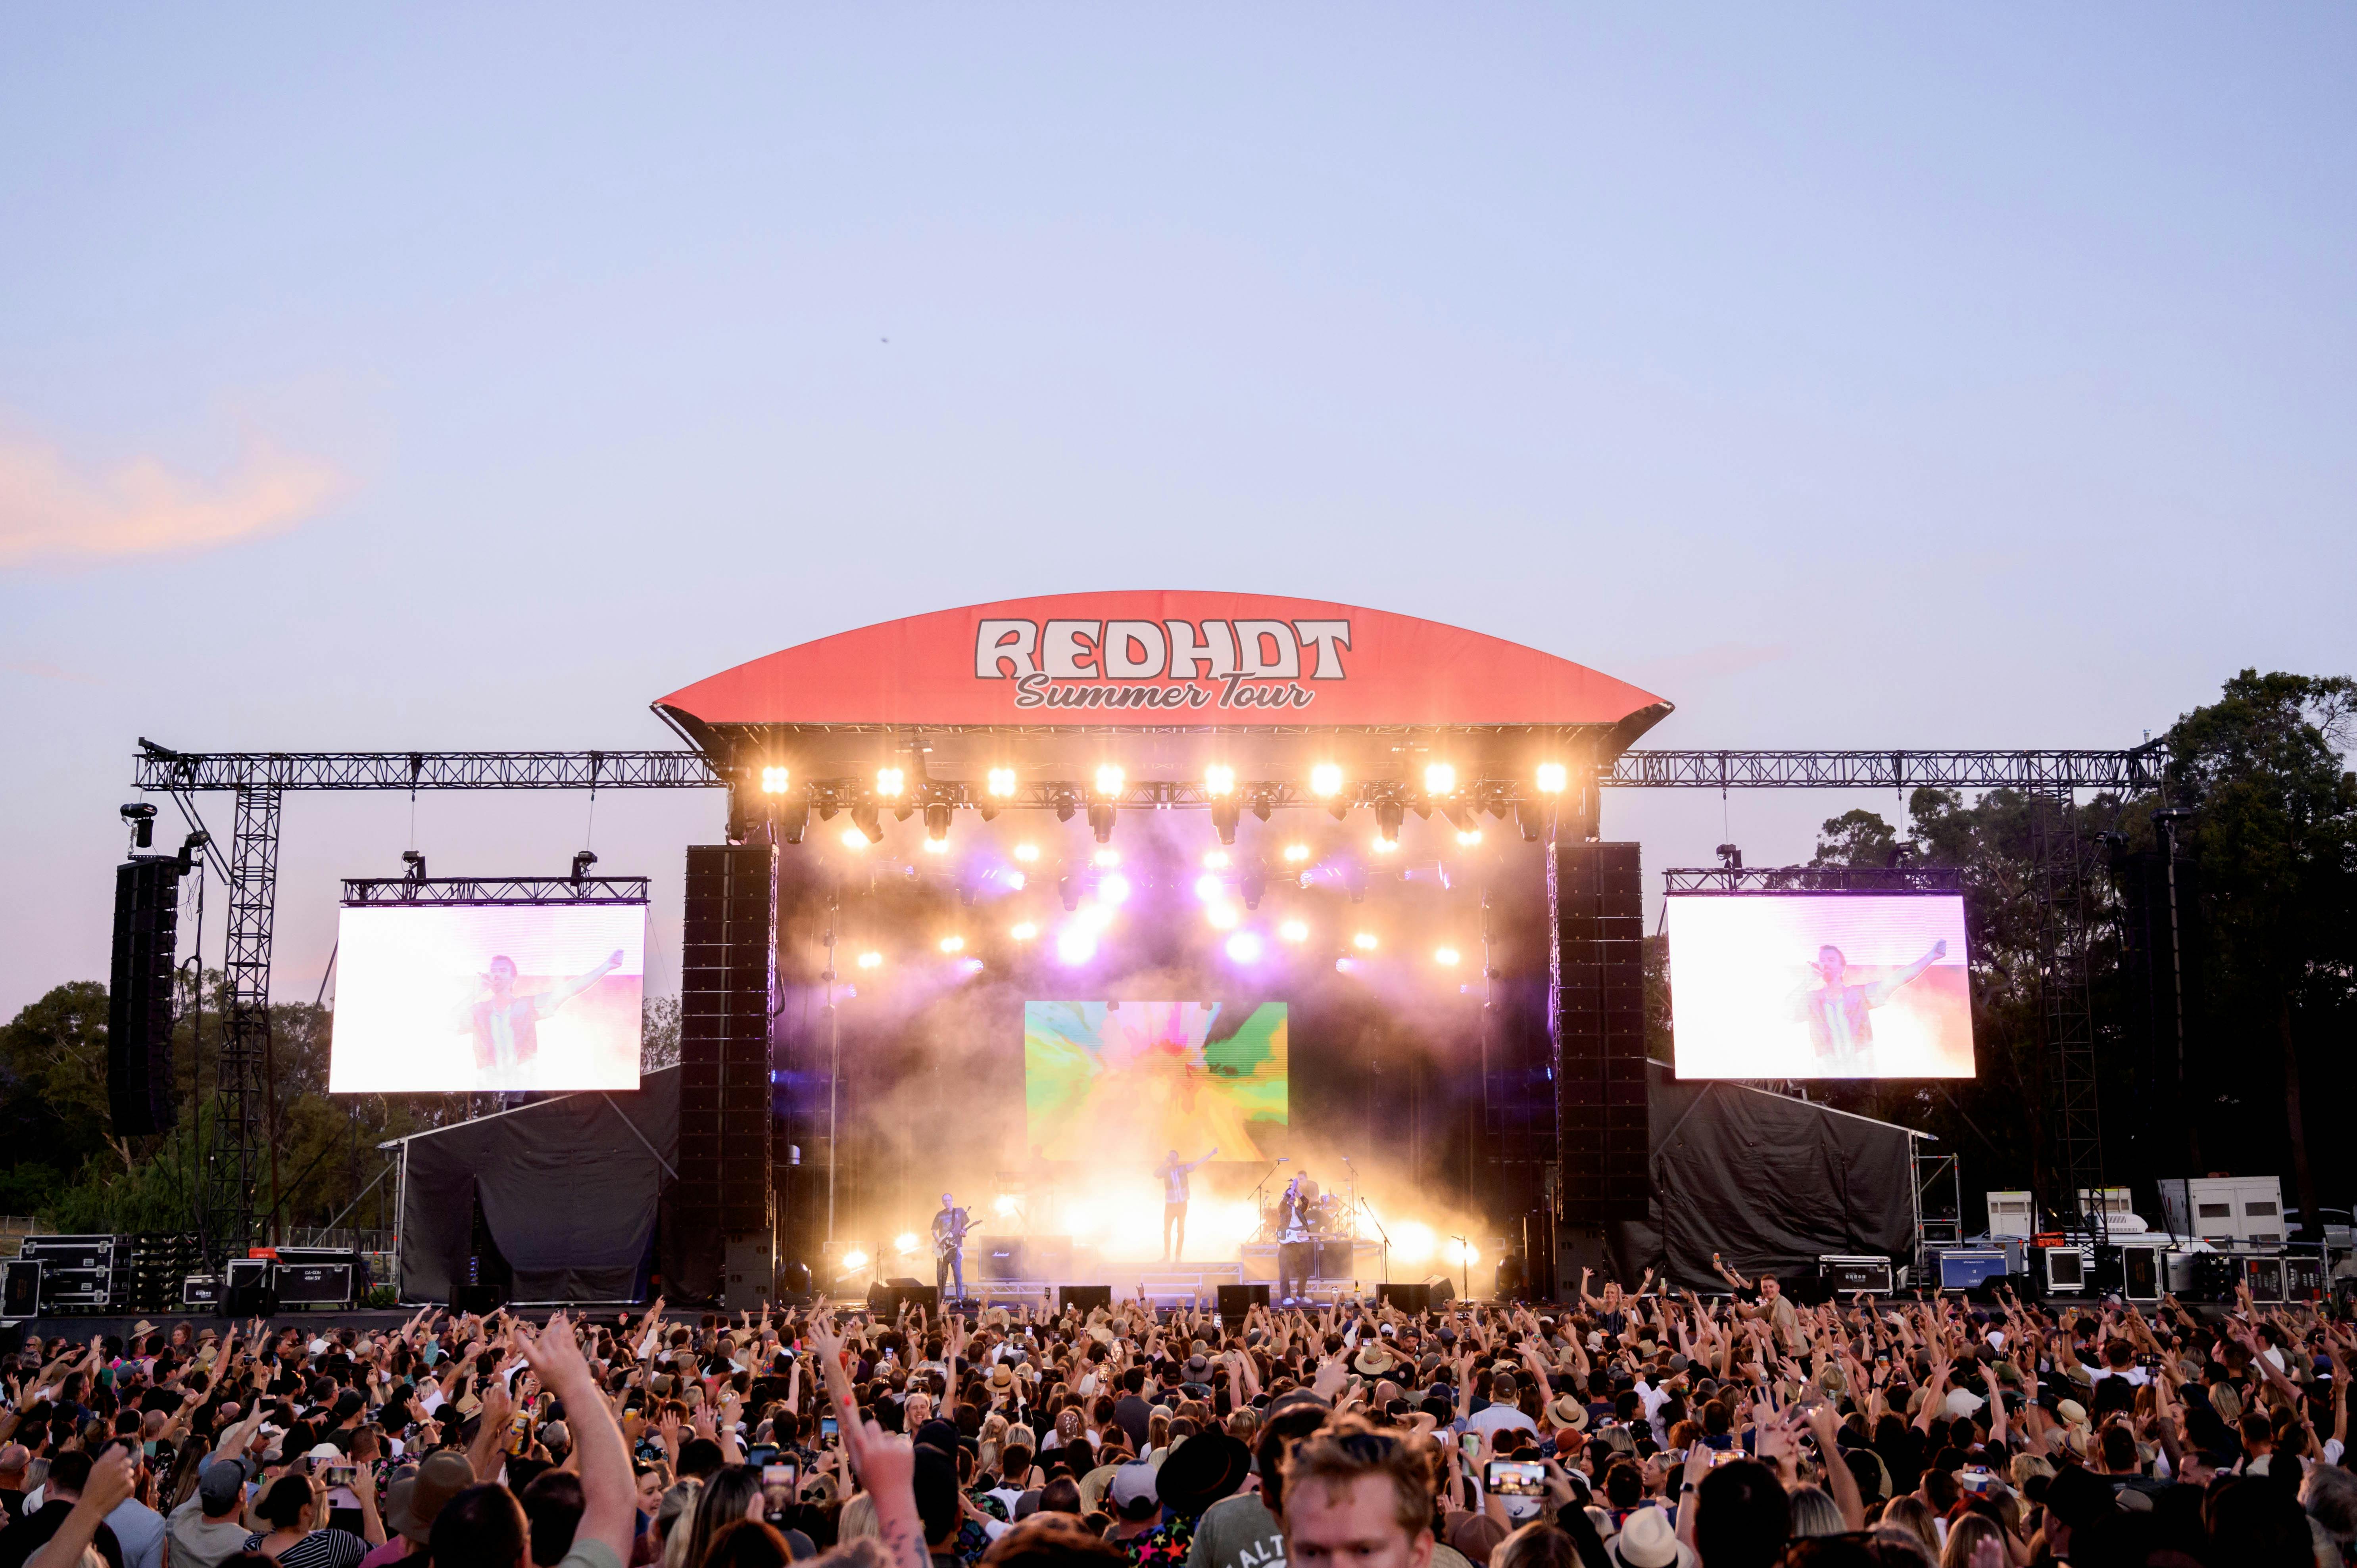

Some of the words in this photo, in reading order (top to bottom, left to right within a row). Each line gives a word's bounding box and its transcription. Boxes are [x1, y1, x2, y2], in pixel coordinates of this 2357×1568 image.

[1014, 671, 1212, 709] Summer
[1217, 672, 1315, 709] Tour
[1226, 1534, 1284, 1568] ALT
